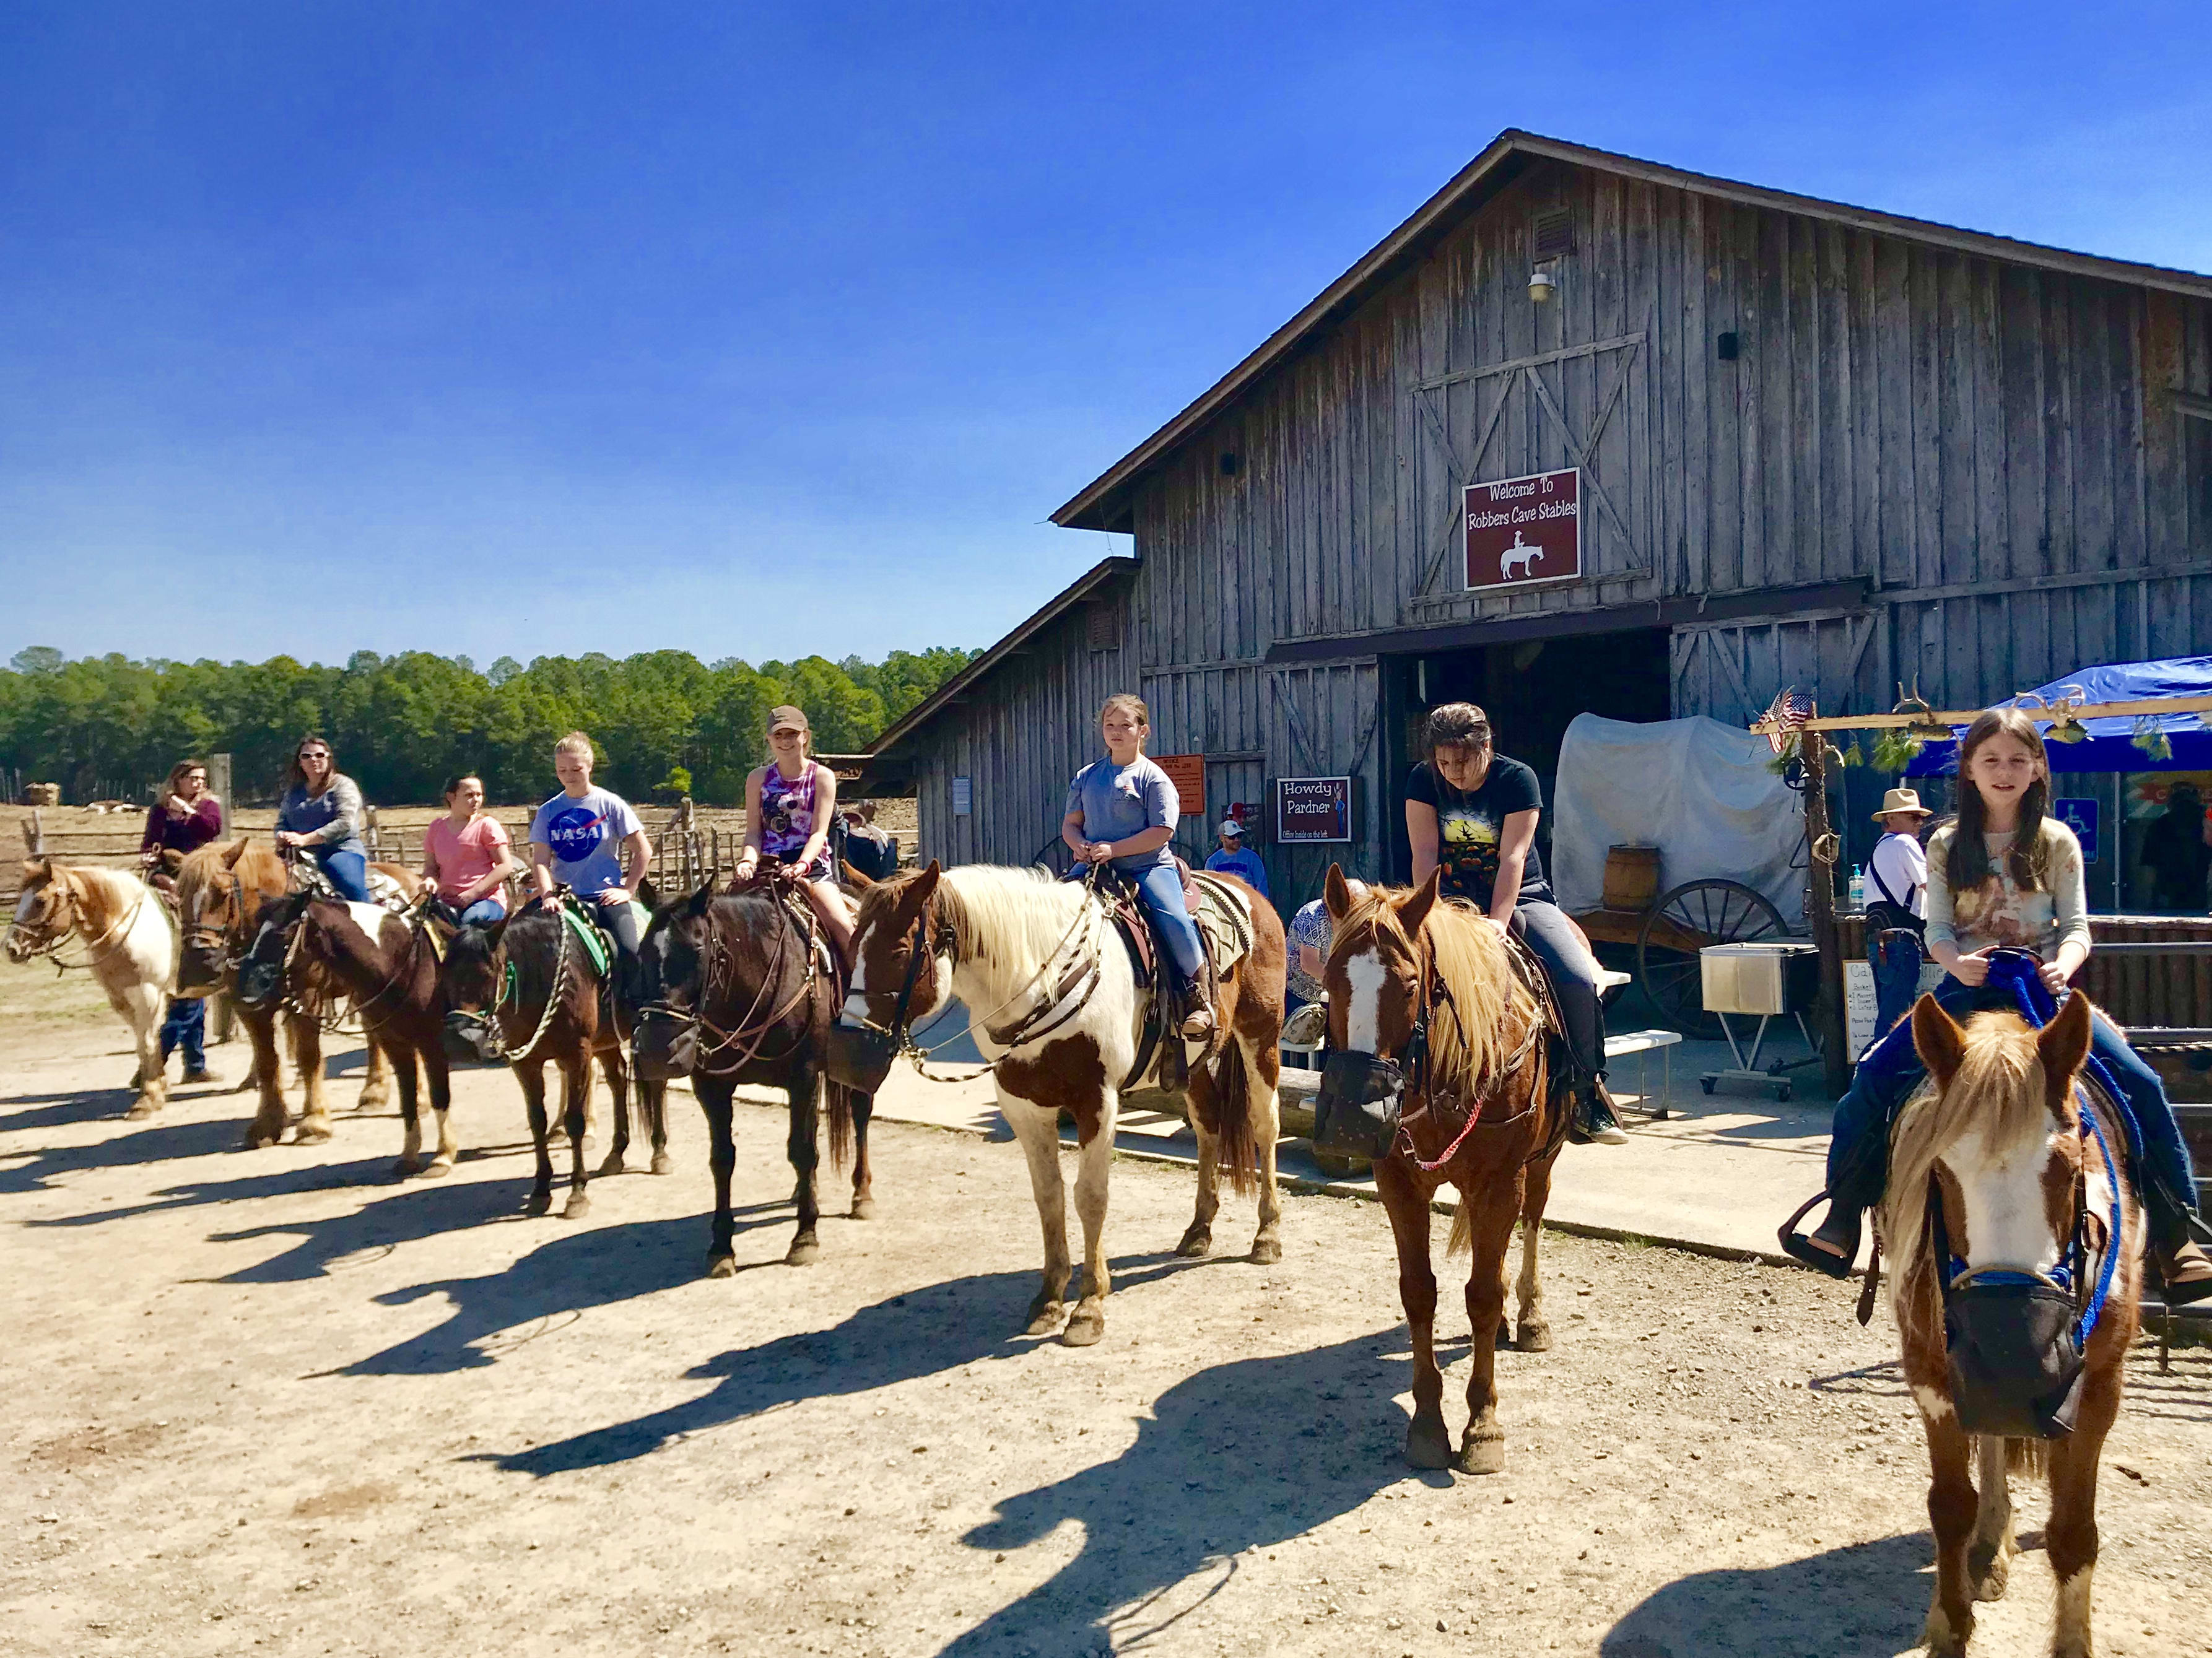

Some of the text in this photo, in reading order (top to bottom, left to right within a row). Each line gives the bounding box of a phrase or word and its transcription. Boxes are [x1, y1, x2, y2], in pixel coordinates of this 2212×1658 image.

[1489, 475, 1554, 501] Welcome To
[1468, 500, 1576, 530] Robbers Cave Stables
[1284, 782, 1331, 797] Howdy
[1287, 800, 1330, 814] Pardner
[551, 827, 599, 841] NASA
